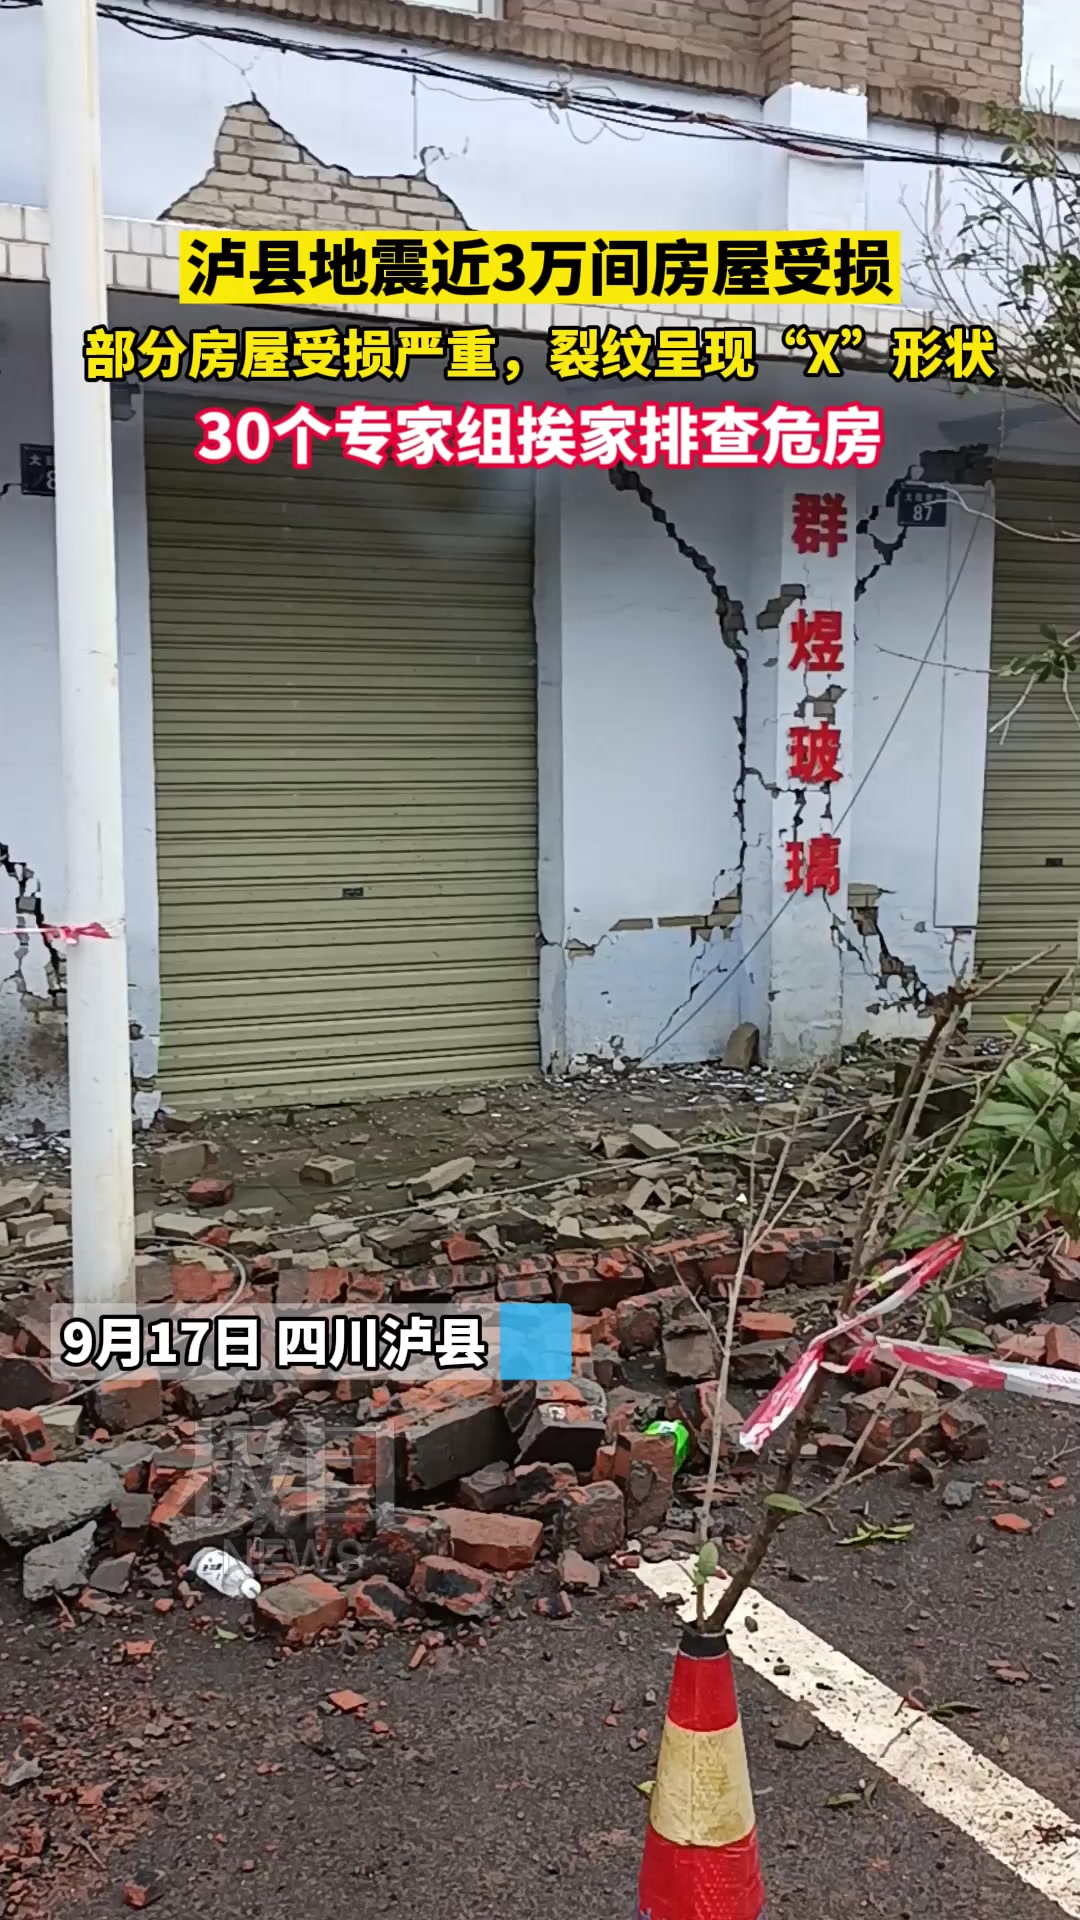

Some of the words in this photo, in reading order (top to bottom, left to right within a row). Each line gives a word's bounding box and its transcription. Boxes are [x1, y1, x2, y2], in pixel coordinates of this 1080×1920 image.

[913, 504, 933, 521] 87
[785, 493, 848, 896] 群煜玻璃
